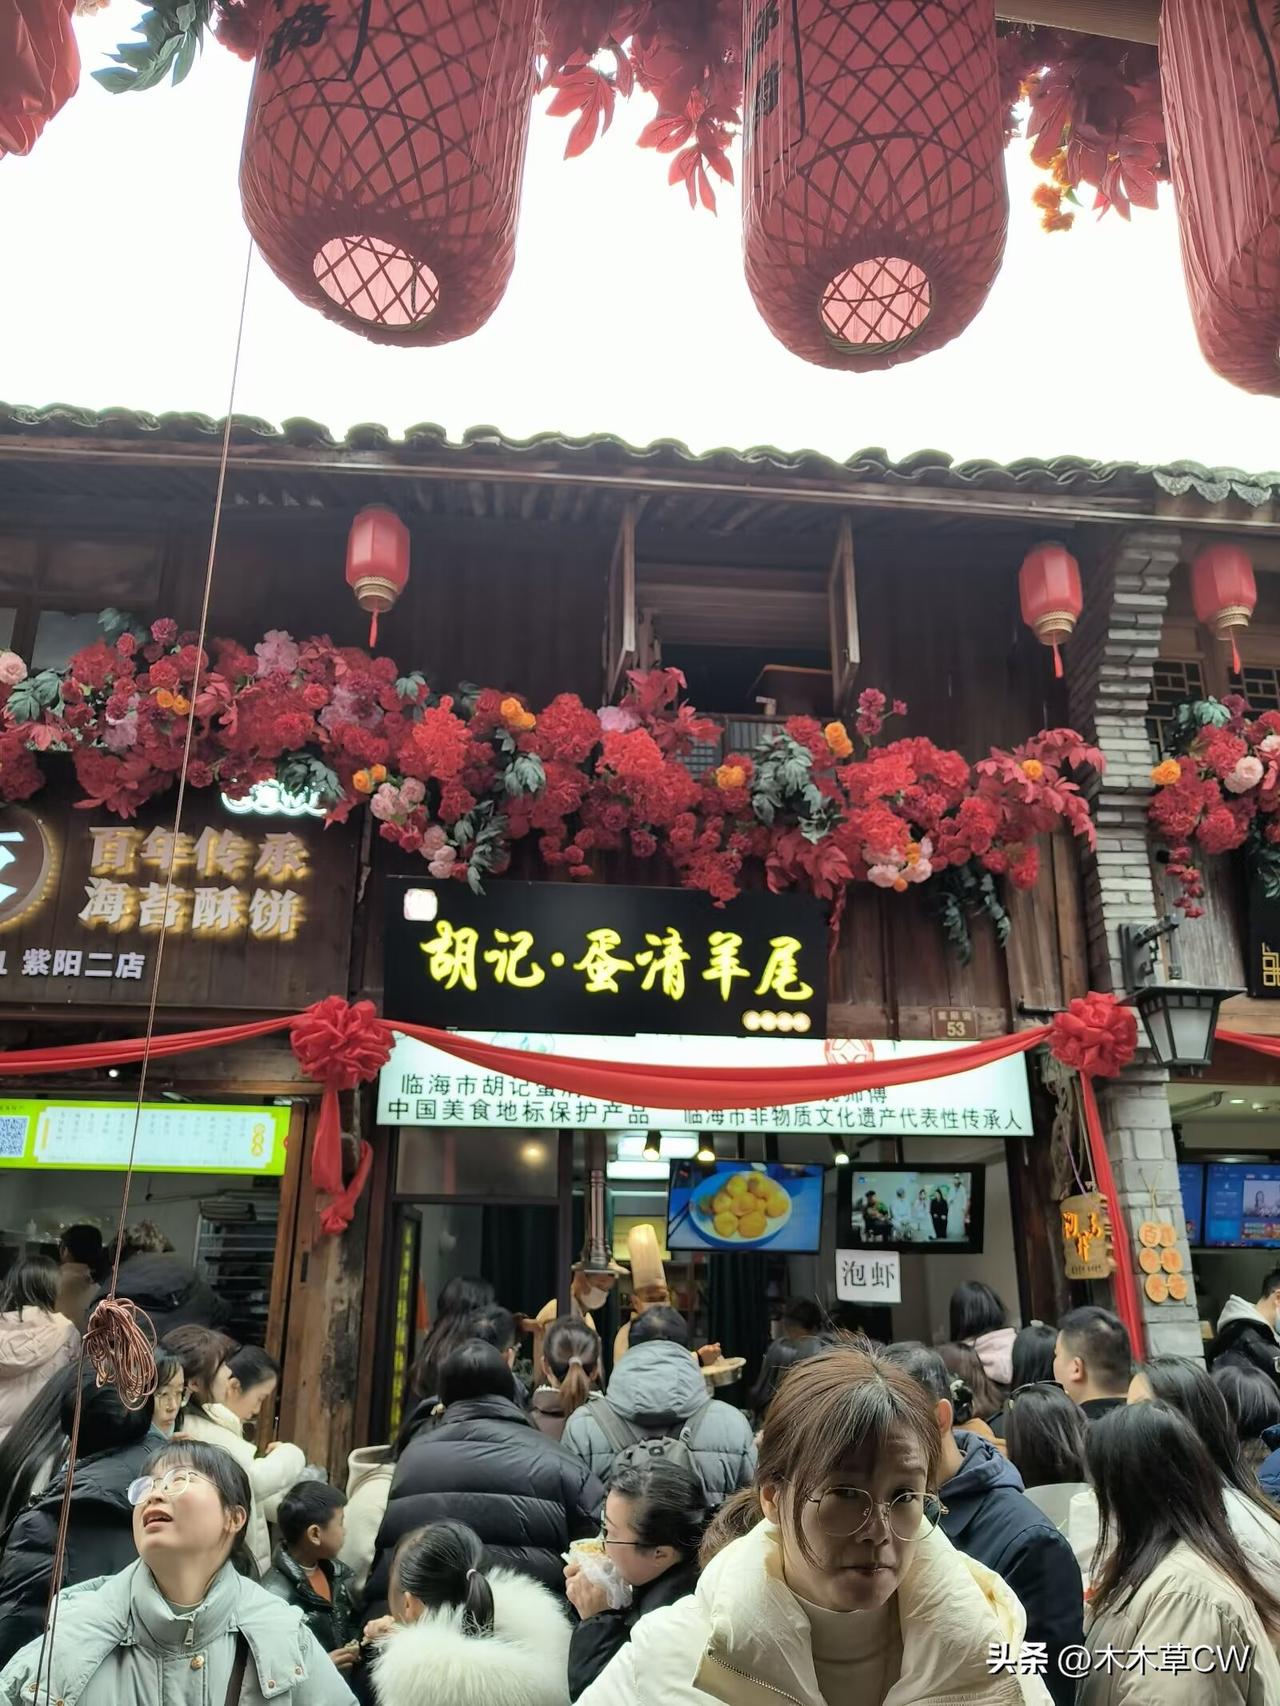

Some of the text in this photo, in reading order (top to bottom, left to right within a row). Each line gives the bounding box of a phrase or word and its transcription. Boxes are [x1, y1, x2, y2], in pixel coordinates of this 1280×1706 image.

[89, 826, 307, 876] 百年传承
[78, 877, 298, 934] 海苔酥饼
[22, 948, 145, 979] 紫阳二店
[947, 1021, 966, 1037] 53
[388, 1098, 1022, 1131] 中国美食地标保护产品 临海市非物质文化遗产代表性传承人
[842, 1260, 896, 1288] 泡虾
